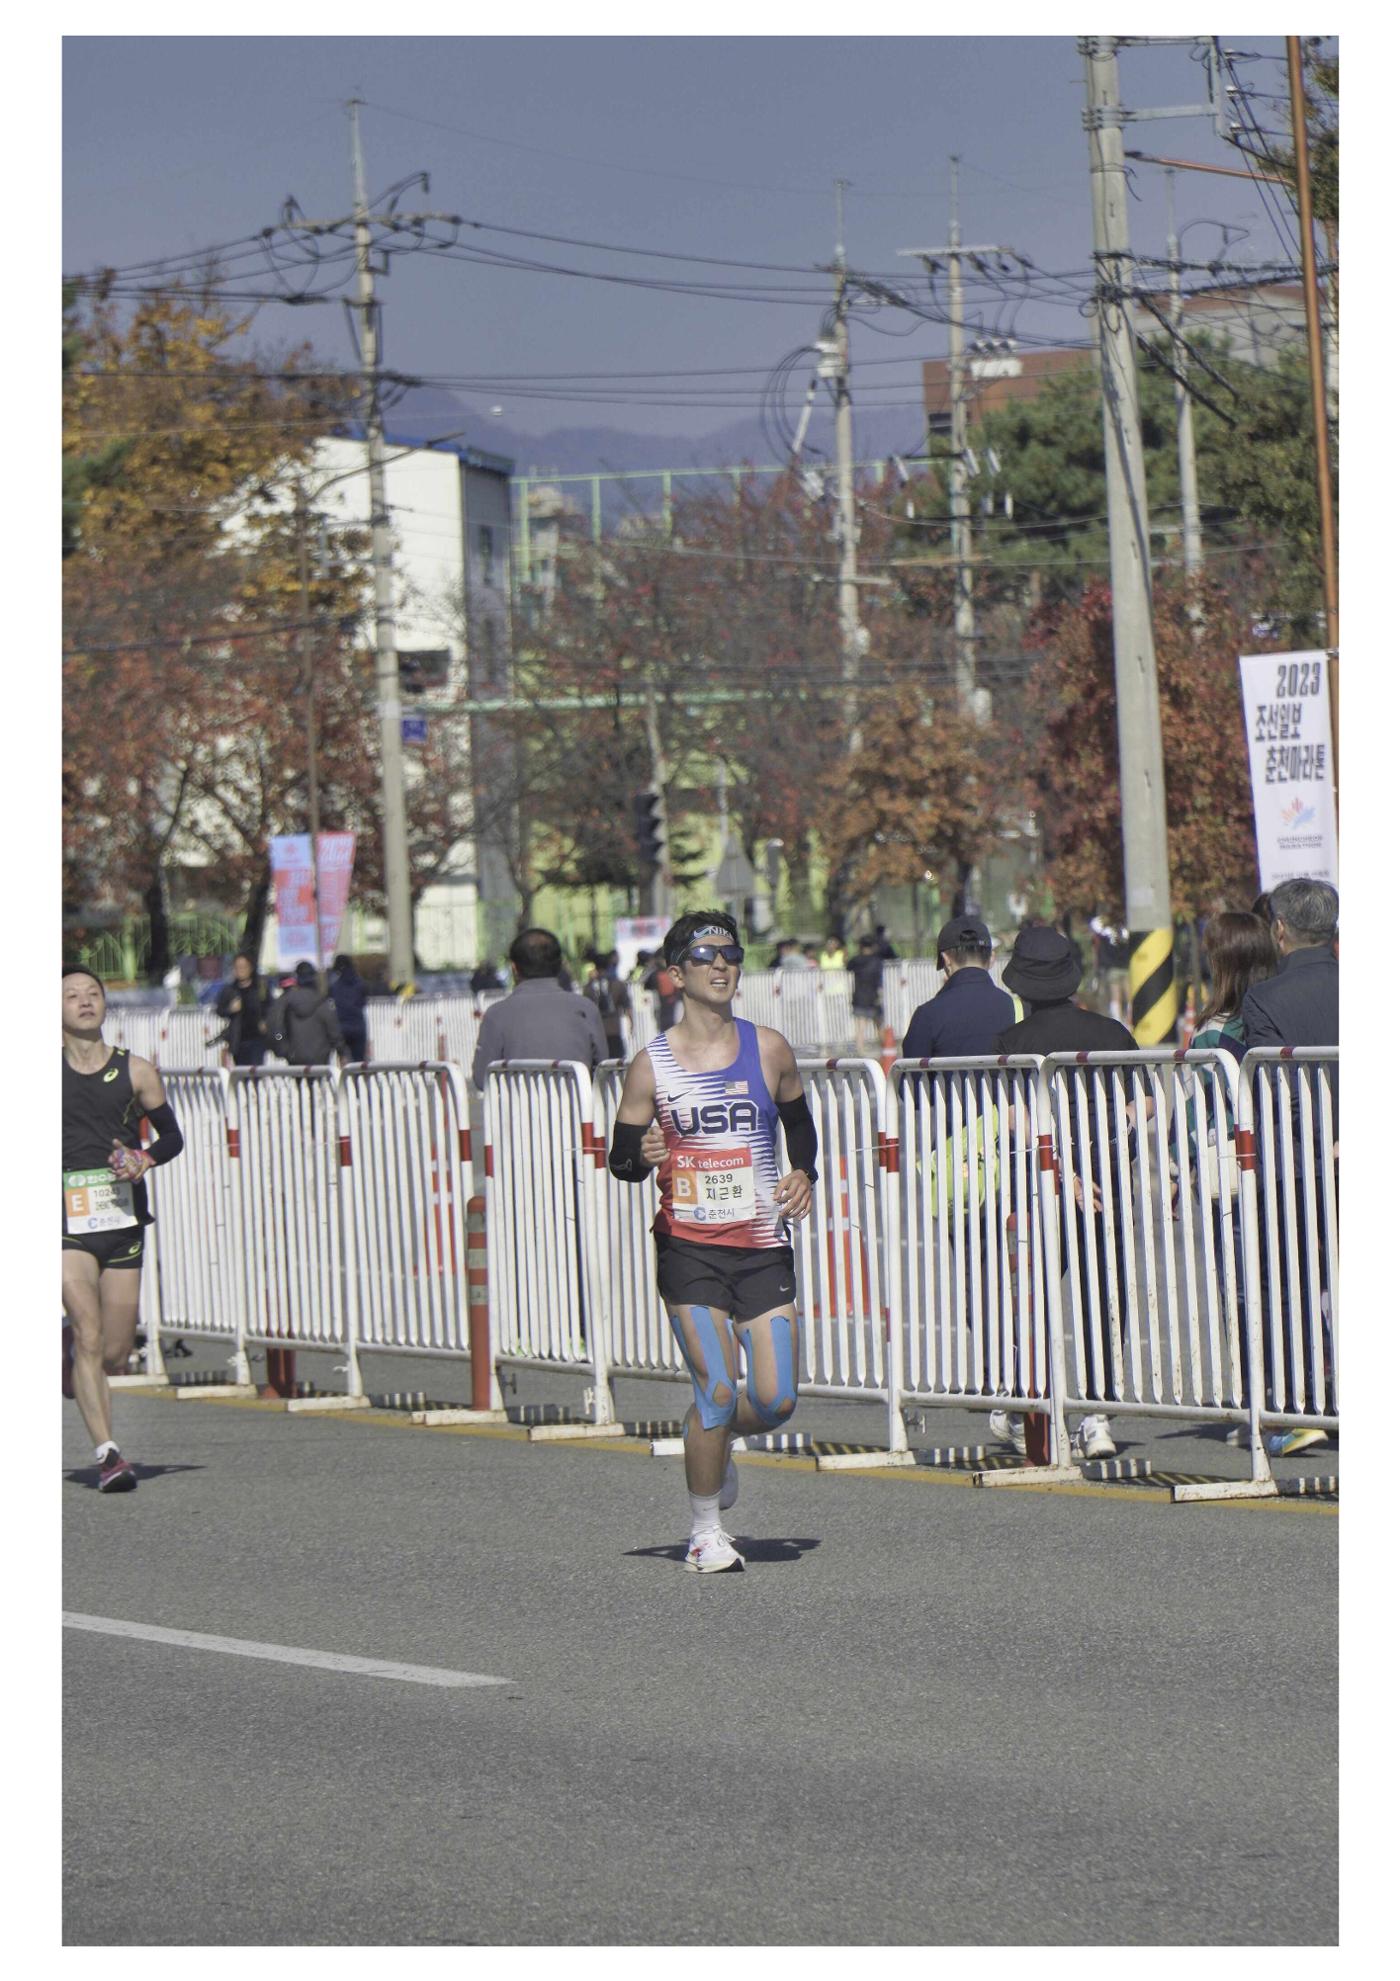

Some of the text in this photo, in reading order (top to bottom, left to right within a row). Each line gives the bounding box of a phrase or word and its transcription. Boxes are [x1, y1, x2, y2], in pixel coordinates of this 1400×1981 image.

[1276, 662, 1321, 698] 2023
[1255, 703, 1301, 742] 조선일보
[1265, 744, 1326, 784] 춘천마라톤
[670, 1100, 758, 1136] USA
[677, 1156, 744, 1169] SK telecom
[677, 1178, 692, 1197] B
[704, 1173, 733, 1185] 2639
[706, 1184, 743, 1201] 지근환
[71, 1193, 84, 1212] E
[708, 1207, 735, 1219] 춘천시
